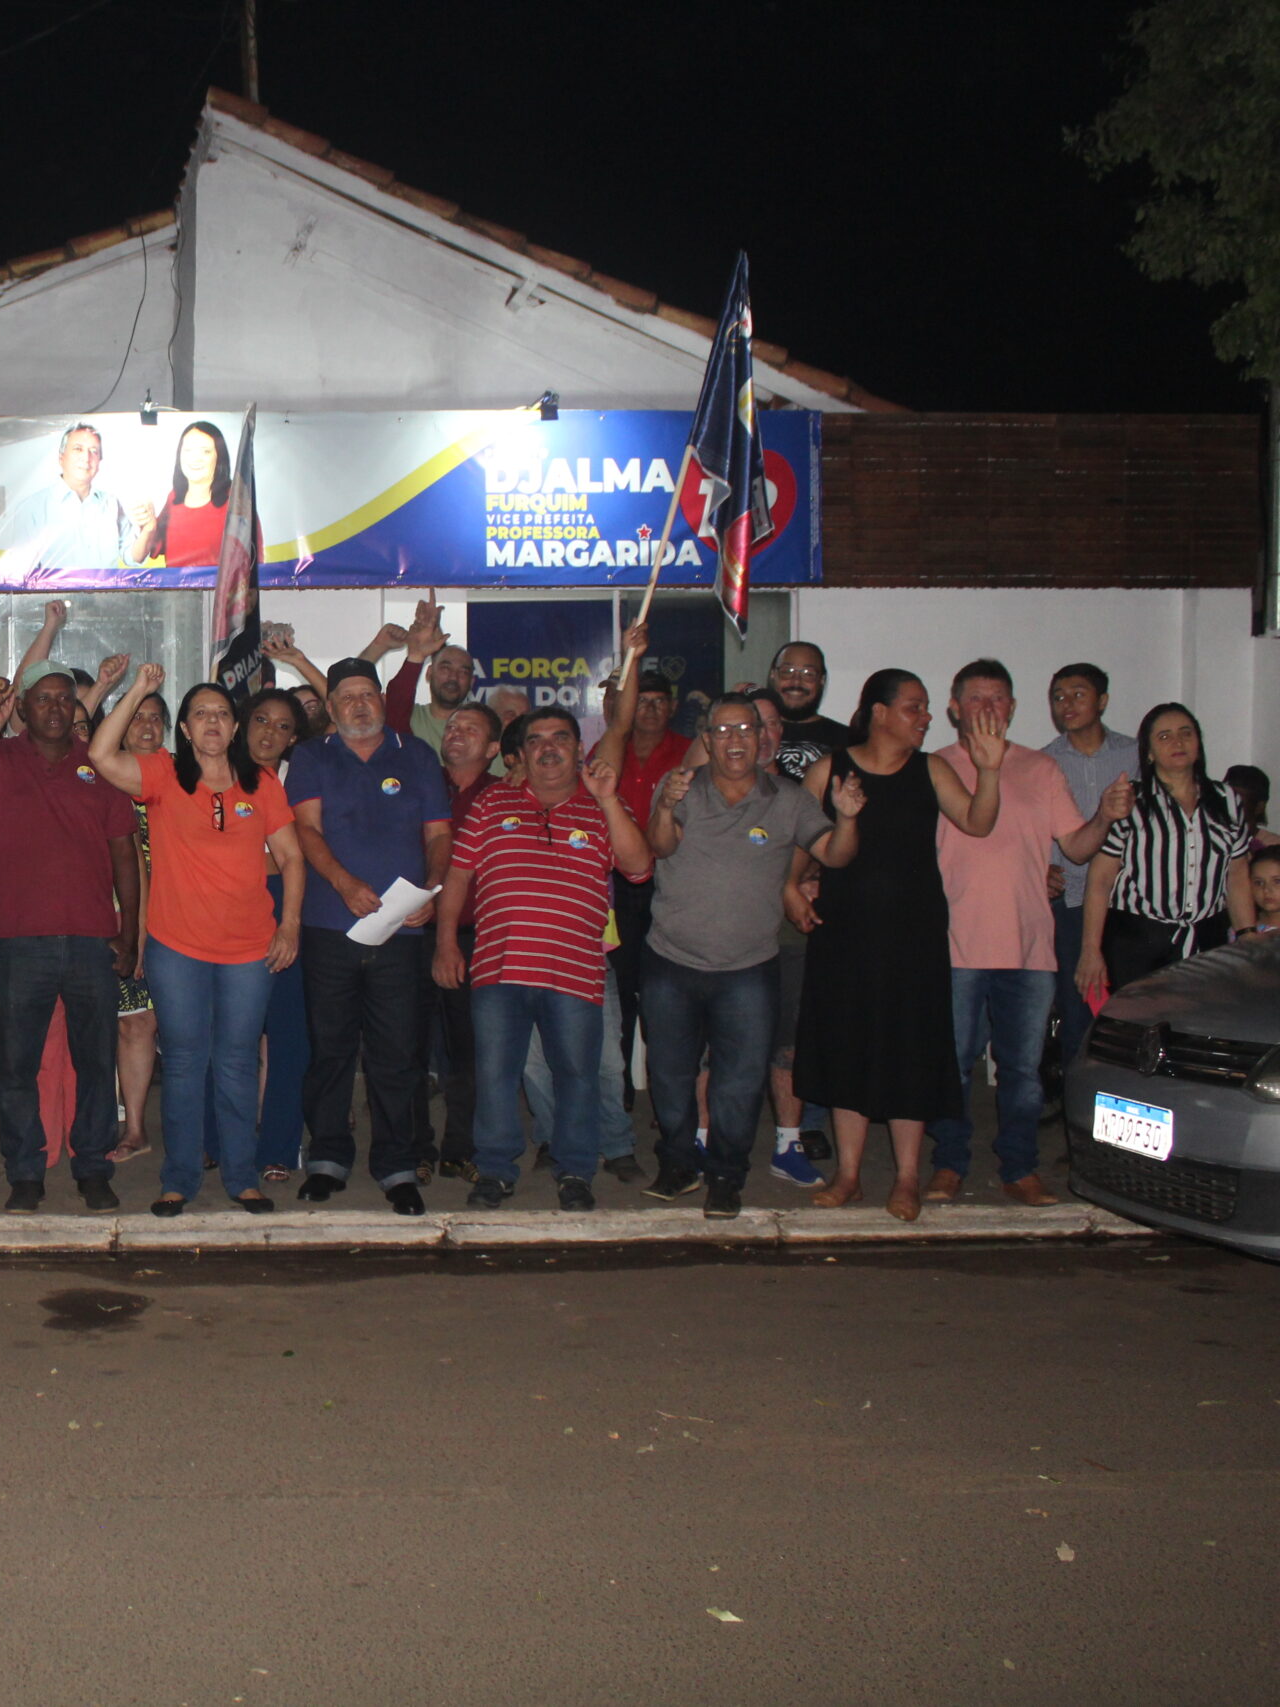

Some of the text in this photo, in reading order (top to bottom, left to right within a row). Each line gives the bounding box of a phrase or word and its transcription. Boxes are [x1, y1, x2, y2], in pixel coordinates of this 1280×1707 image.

[485, 457, 675, 493] DJALMA
[486, 494, 588, 515] FURQUIM
[487, 514, 595, 525] VICE PREFEITA
[487, 526, 600, 540] PROFESSORA
[486, 540, 703, 567] MARGARIDA
[492, 657, 591, 684] FORÇA
[535, 686, 580, 707] DO
